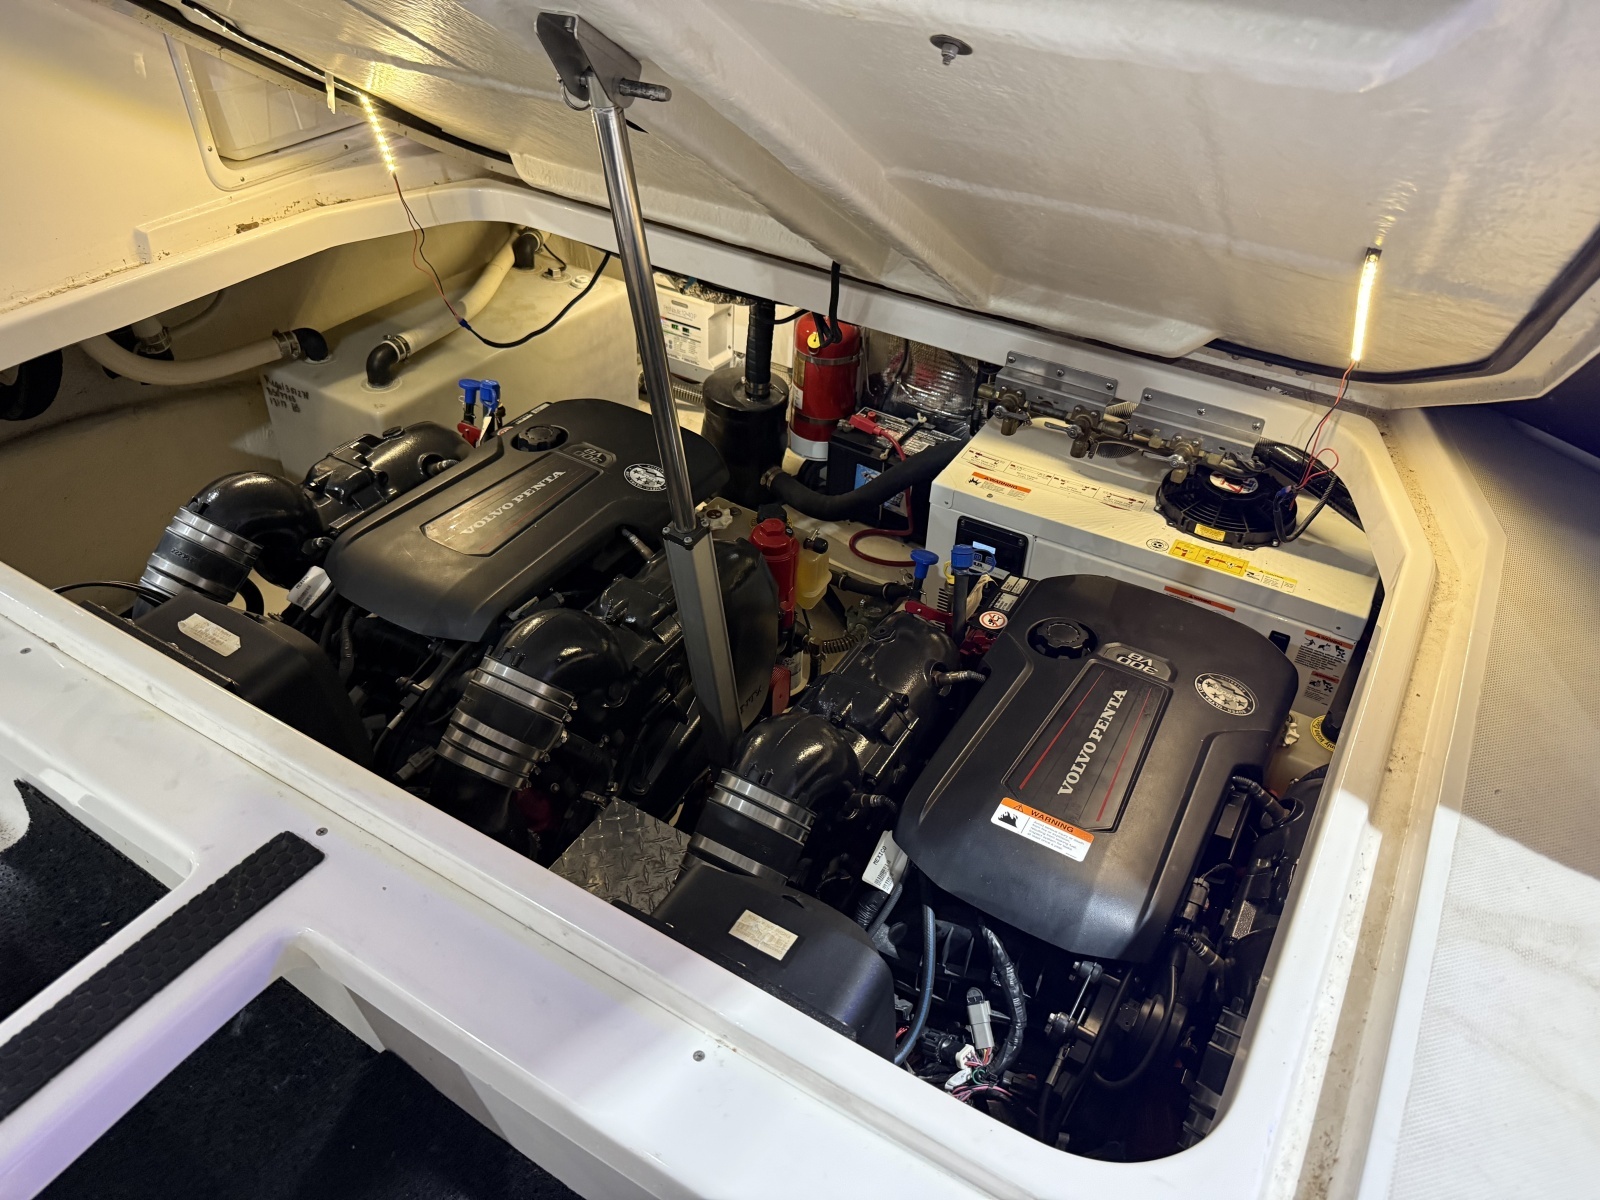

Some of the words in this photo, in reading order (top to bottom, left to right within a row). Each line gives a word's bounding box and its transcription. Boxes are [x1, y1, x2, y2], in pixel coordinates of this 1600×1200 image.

[573, 450, 603, 465] 300
[583, 448, 602, 459] V8
[988, 476, 1018, 490] WARNING
[460, 502, 514, 535] VOLVO
[512, 470, 566, 504] PENTA
[1117, 655, 1159, 676] 300
[1128, 651, 1153, 667] V8
[1057, 741, 1097, 795] VOLVO
[1088, 689, 1128, 742] PENTA
[1030, 809, 1074, 834] WARNING
[872, 845, 887, 866] MEXICO
